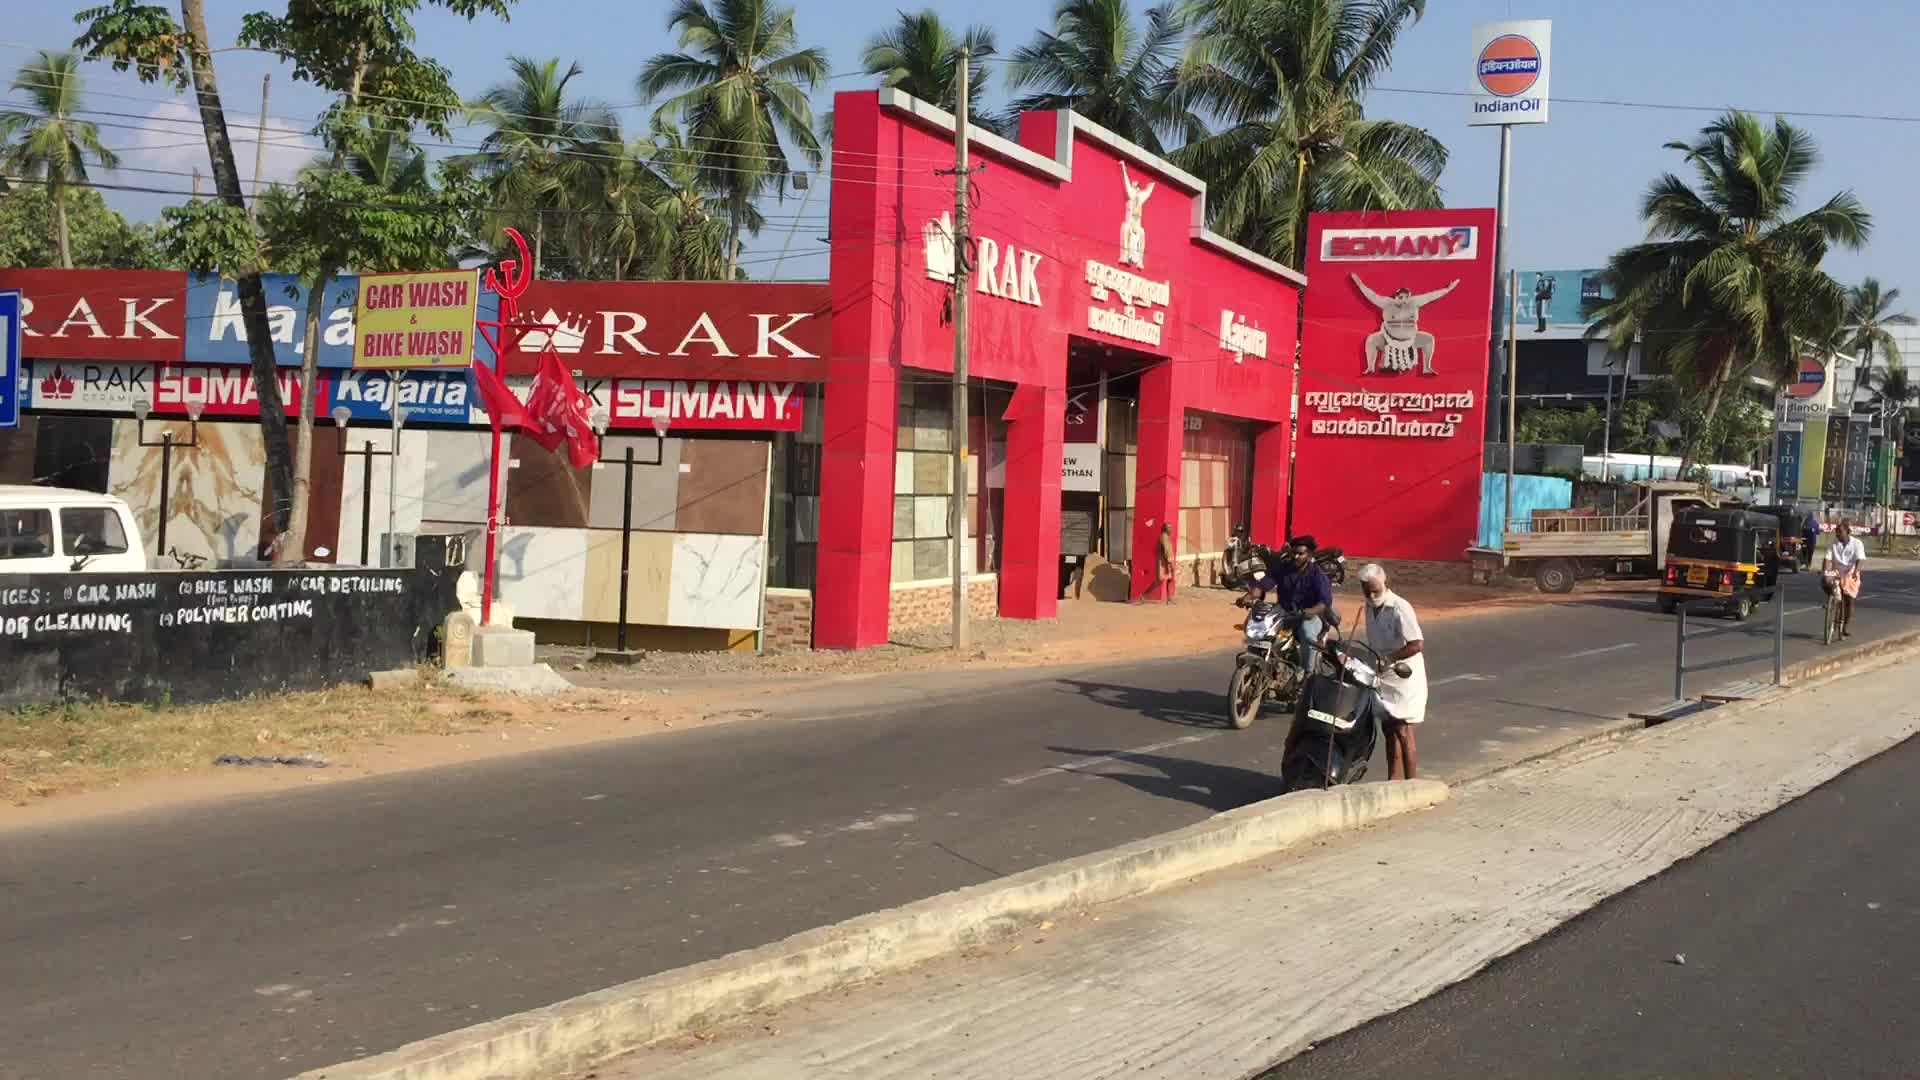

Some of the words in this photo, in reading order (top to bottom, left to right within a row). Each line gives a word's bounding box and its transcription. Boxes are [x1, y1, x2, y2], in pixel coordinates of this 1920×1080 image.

[1474, 99, 1540, 113] IndianOil
[1330, 234, 1463, 257] SOMANY
[976, 236, 1043, 307] RAK
[366, 284, 404, 310] CAR
[408, 280, 469, 307] WASH
[363, 332, 404, 358] BIKE
[407, 330, 465, 356] WASH
[594, 310, 821, 359] RAK
[83, 365, 147, 393] RAK
[336, 371, 468, 411] Kajaria
[616, 382, 795, 420] SOMANY
[1063, 457, 1077, 466] EW
[77, 583, 110, 602] CAR
[115, 582, 157, 601] WASH
[194, 578, 228, 595] BIKE
[233, 577, 273, 595] WASH
[300, 576, 327, 595] CAR
[331, 576, 403, 594] DETAILING
[34, 612, 132, 633] CLEANING
[176, 606, 249, 626] POLYMER
[251, 599, 313, 622] COATING
